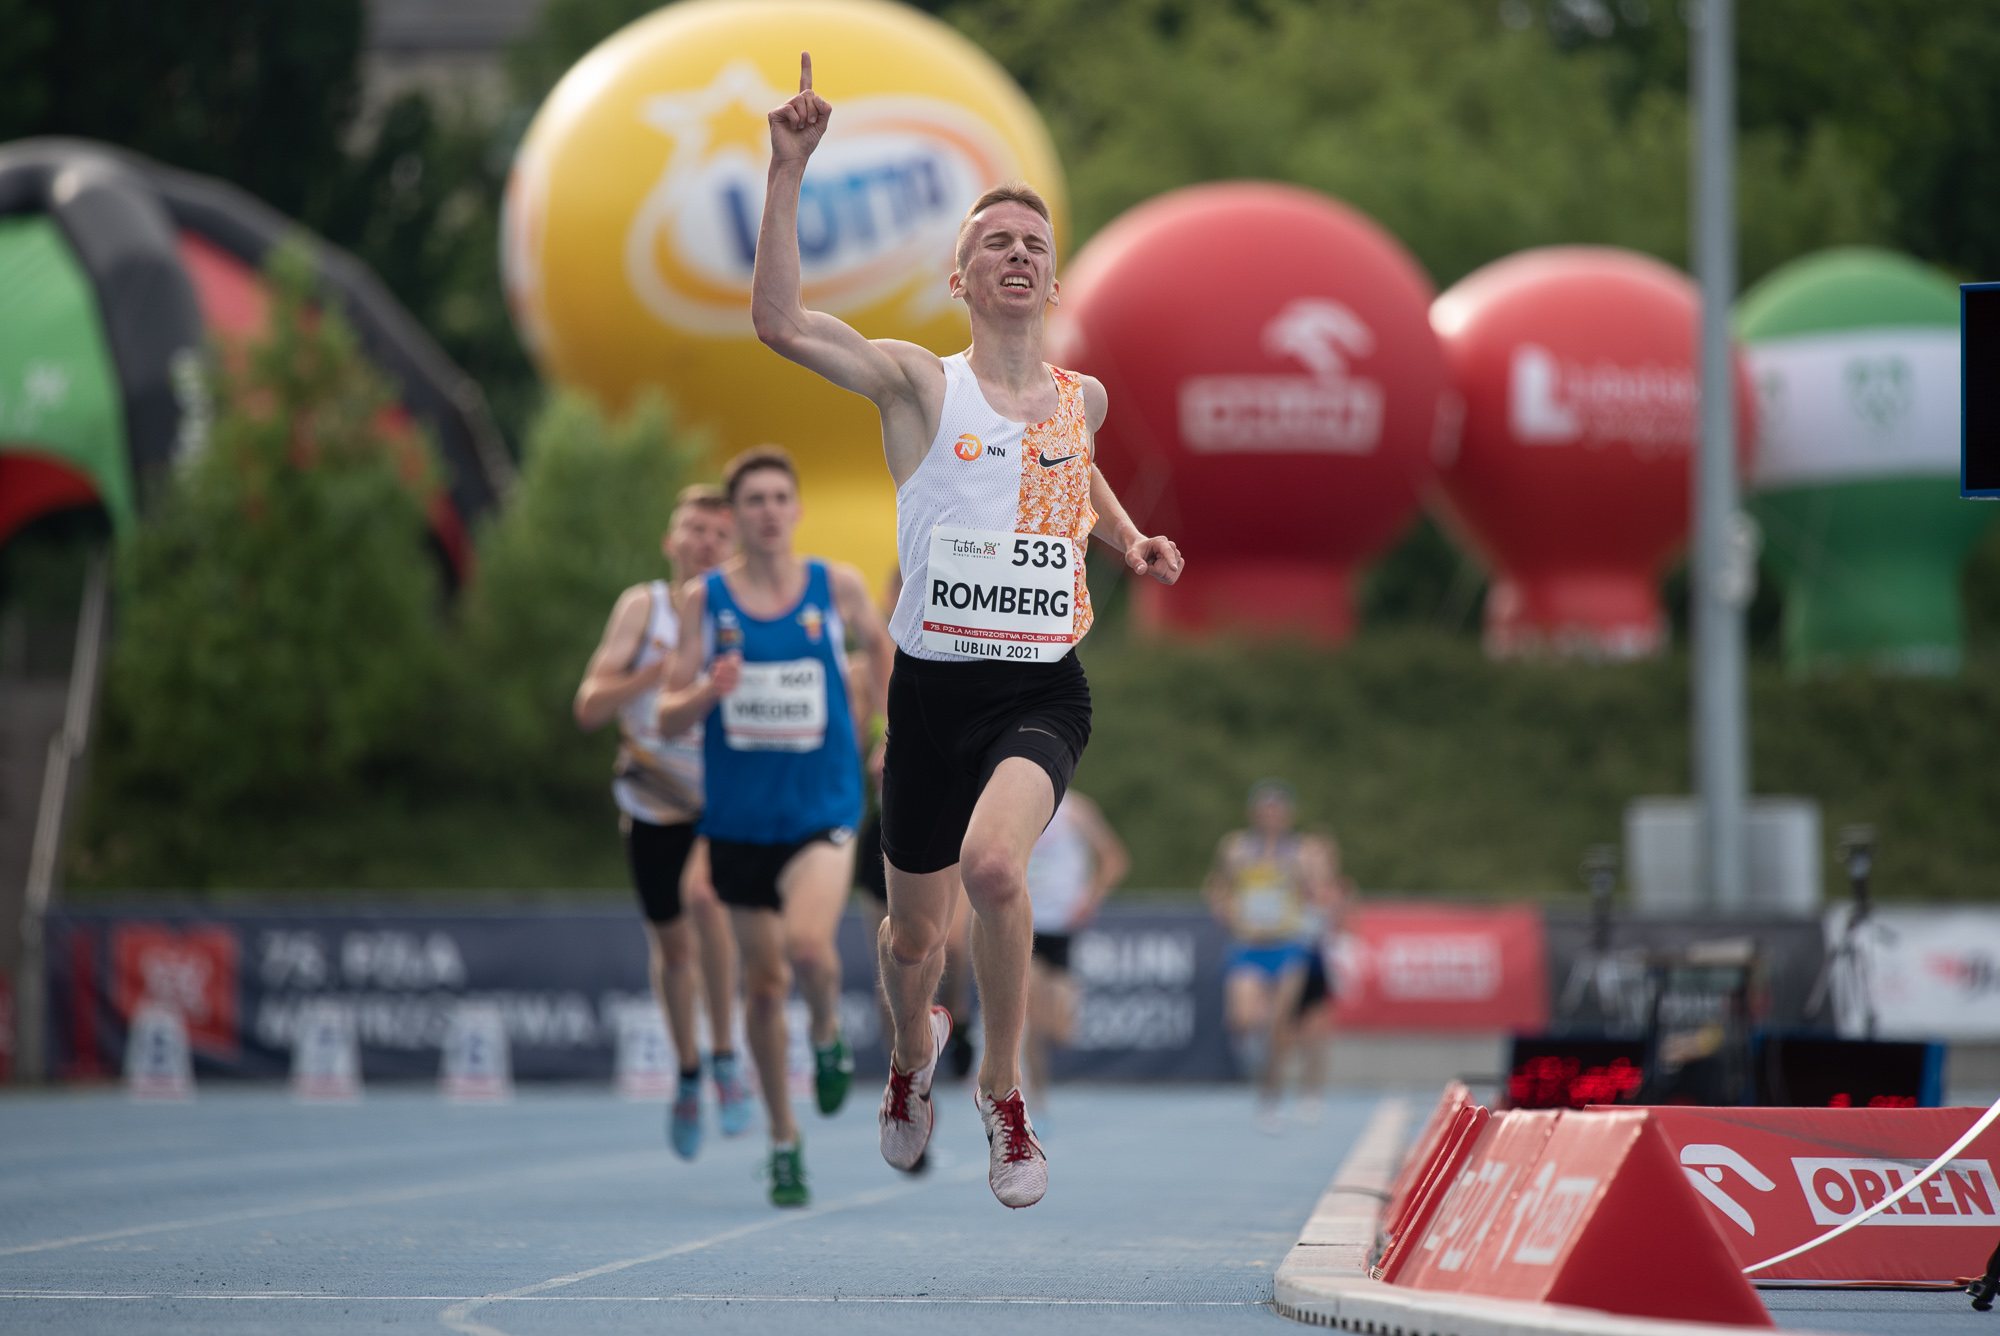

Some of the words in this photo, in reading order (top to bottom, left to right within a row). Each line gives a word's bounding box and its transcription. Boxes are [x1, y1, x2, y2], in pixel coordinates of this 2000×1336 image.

[987, 445, 1005, 457] NN
[1011, 539, 1067, 569] 533
[931, 579, 1069, 617] ROMBERG
[943, 625, 963, 634] PZLA
[964, 628, 1021, 640] MISTRZOSTWA
[1022, 633, 1049, 642] POLSKI
[954, 639, 1001, 657] LUBLIN
[1006, 645, 1039, 660] 2021
[1812, 1167, 1996, 1216] ORLEN
